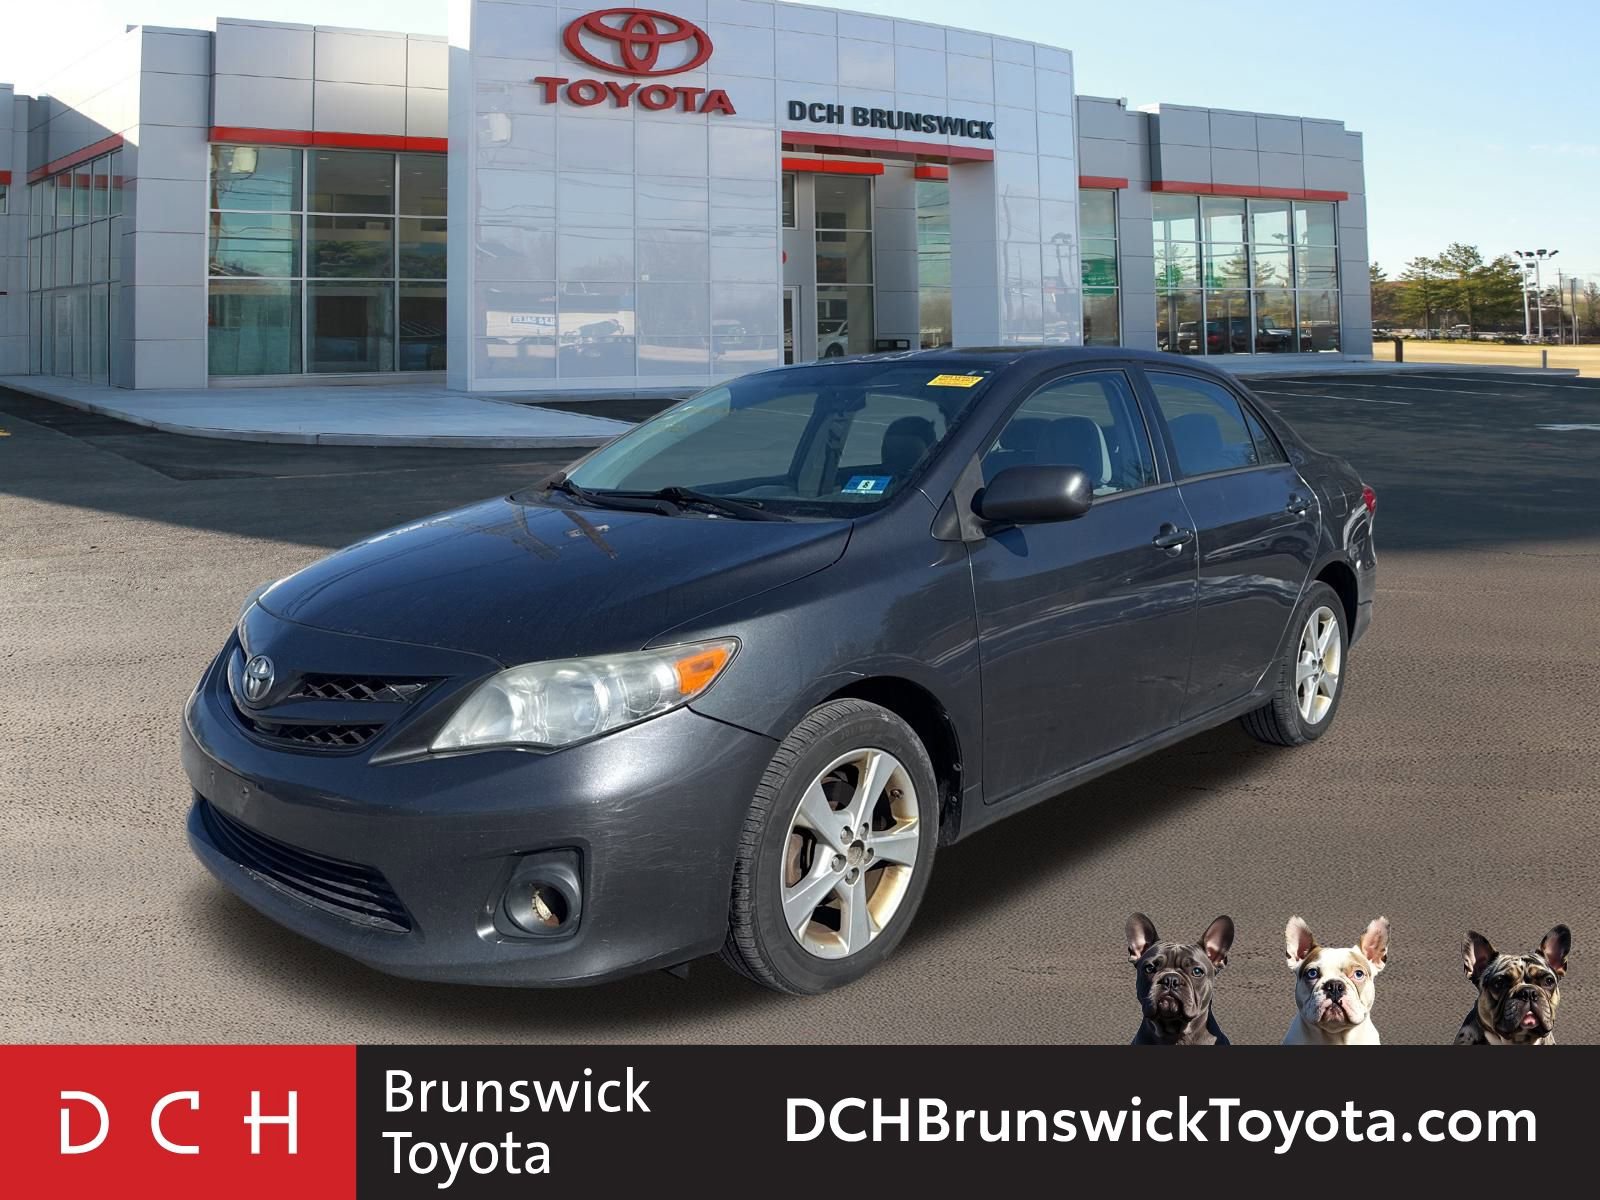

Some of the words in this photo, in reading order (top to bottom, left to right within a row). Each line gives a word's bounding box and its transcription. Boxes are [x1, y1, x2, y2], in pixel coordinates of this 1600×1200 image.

[534, 76, 736, 115] TOYOTA
[788, 100, 845, 125] DCH
[852, 107, 995, 140] BRUNSWICK
